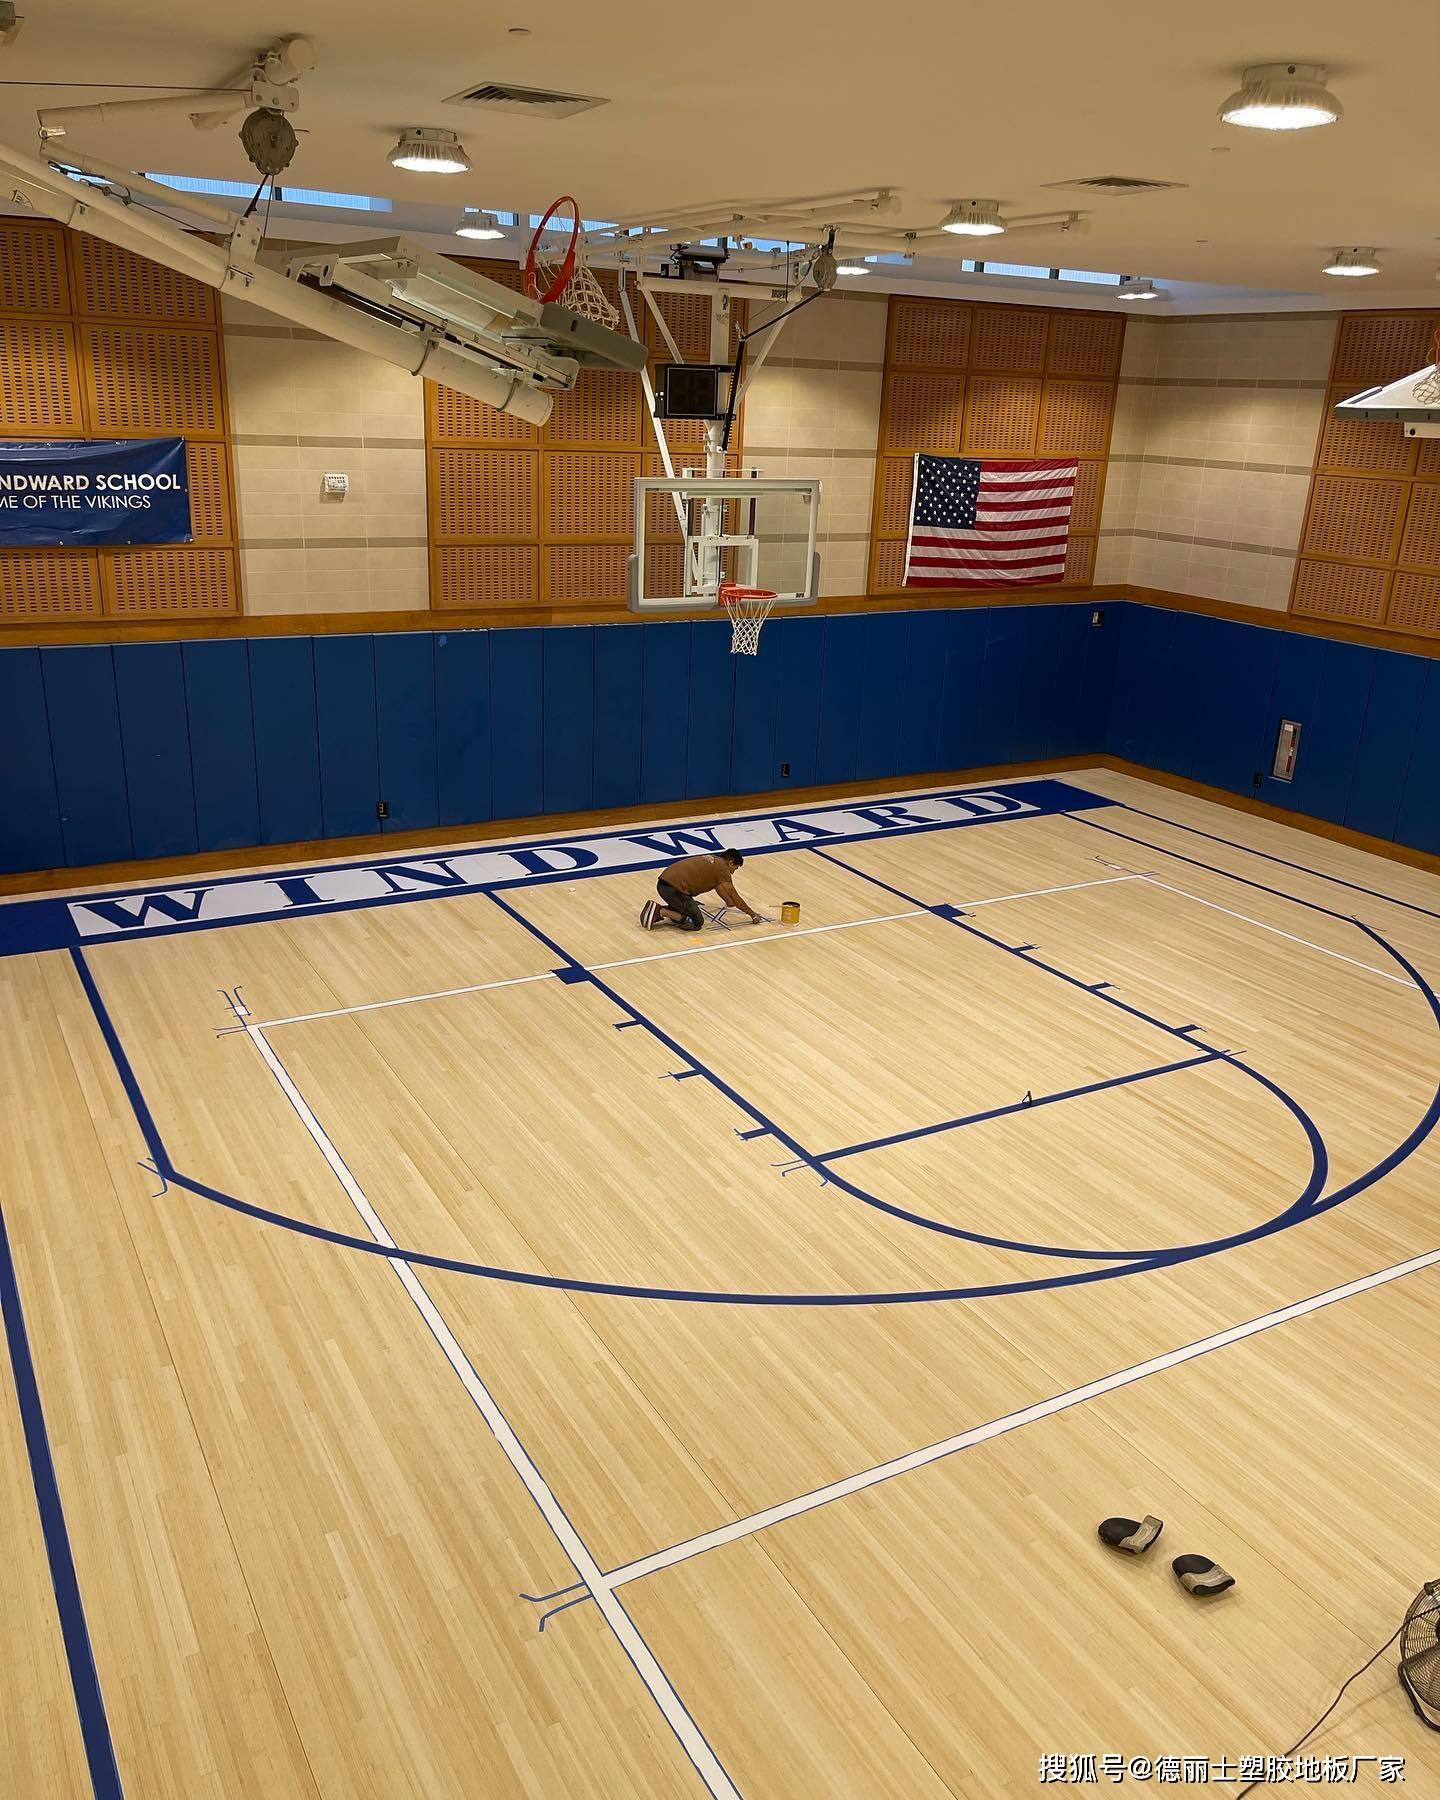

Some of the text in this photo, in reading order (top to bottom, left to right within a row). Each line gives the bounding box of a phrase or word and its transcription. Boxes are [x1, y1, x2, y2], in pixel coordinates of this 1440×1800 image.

[96, 473, 181, 490] SCHOOL
[23, 495, 47, 509] OF
[51, 495, 81, 509] THE
[85, 495, 151, 509] VIKINGS
[74, 795, 1021, 928] WINDWARD
